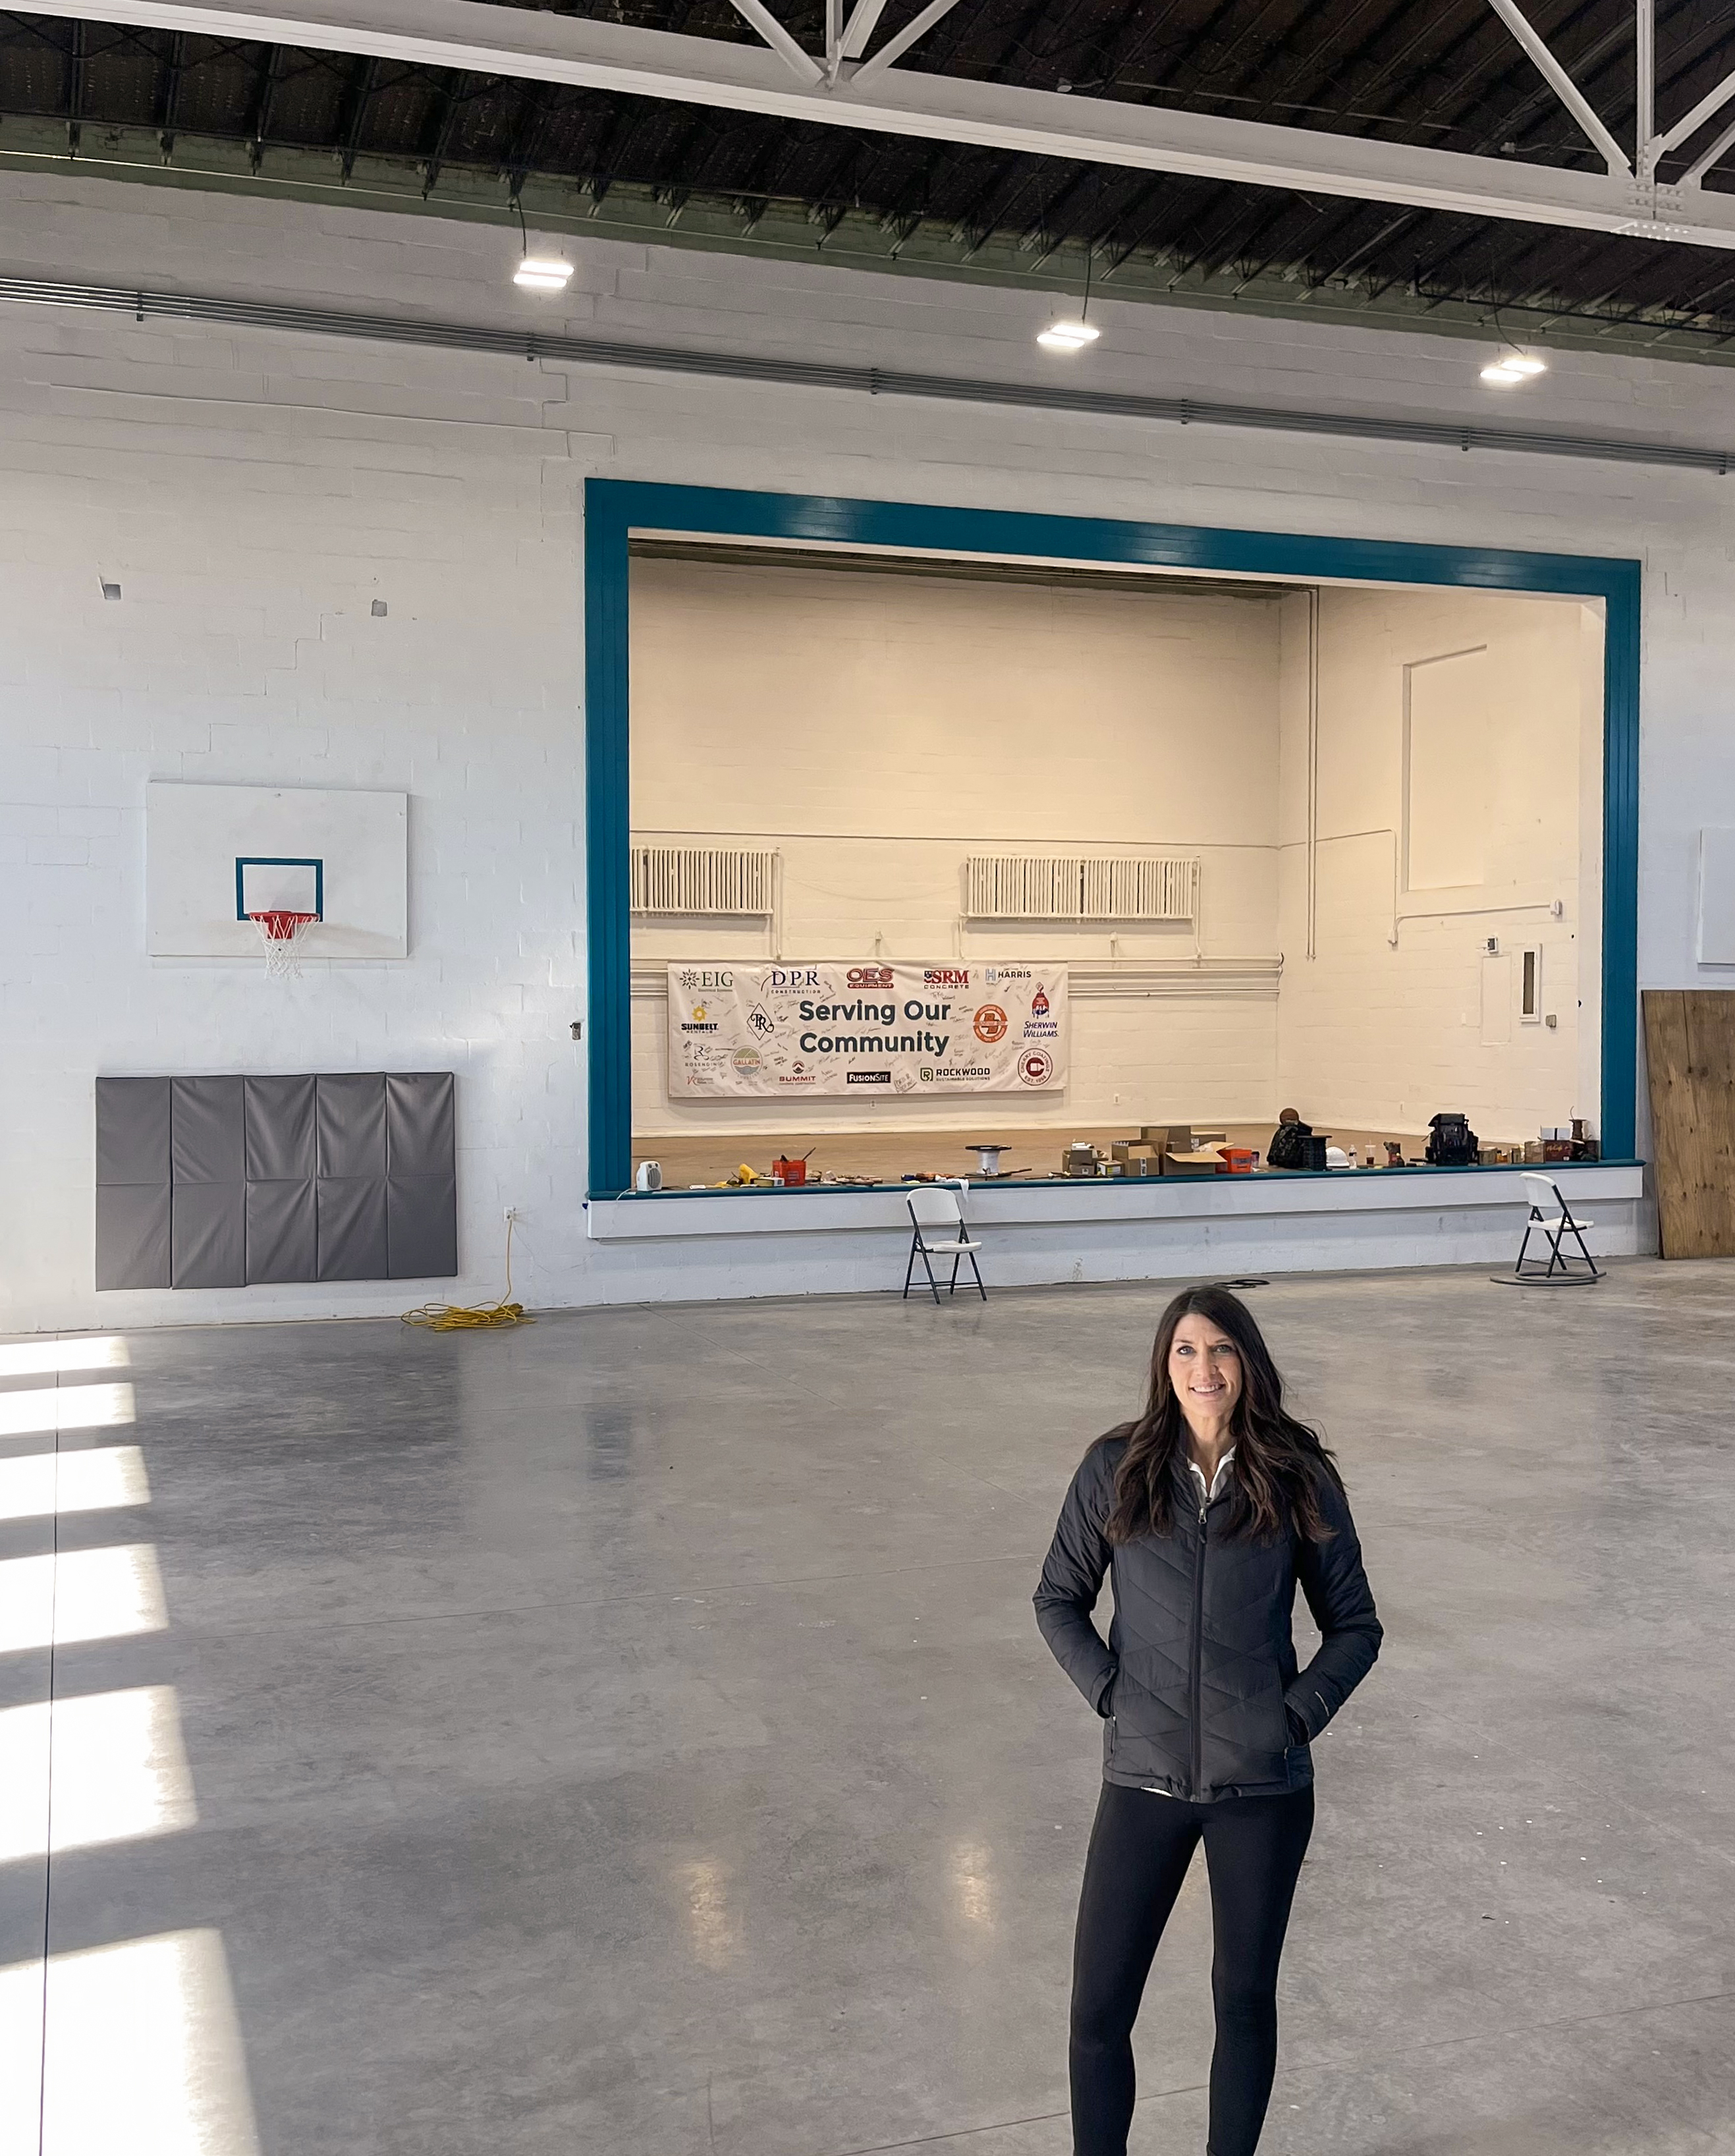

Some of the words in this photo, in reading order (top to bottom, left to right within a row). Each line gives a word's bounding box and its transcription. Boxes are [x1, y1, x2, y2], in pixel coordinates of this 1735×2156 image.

[702, 971, 733, 987] EIG
[771, 970, 820, 986] DPR
[846, 967, 895, 982] OES
[931, 970, 970, 984] SRM
[799, 999, 896, 1026] Serving
[904, 1000, 951, 1020] Our
[800, 1030, 950, 1057] Community
[1020, 1053, 1032, 1073] CHERRY
[1033, 1051, 1050, 1072] COATINGS
